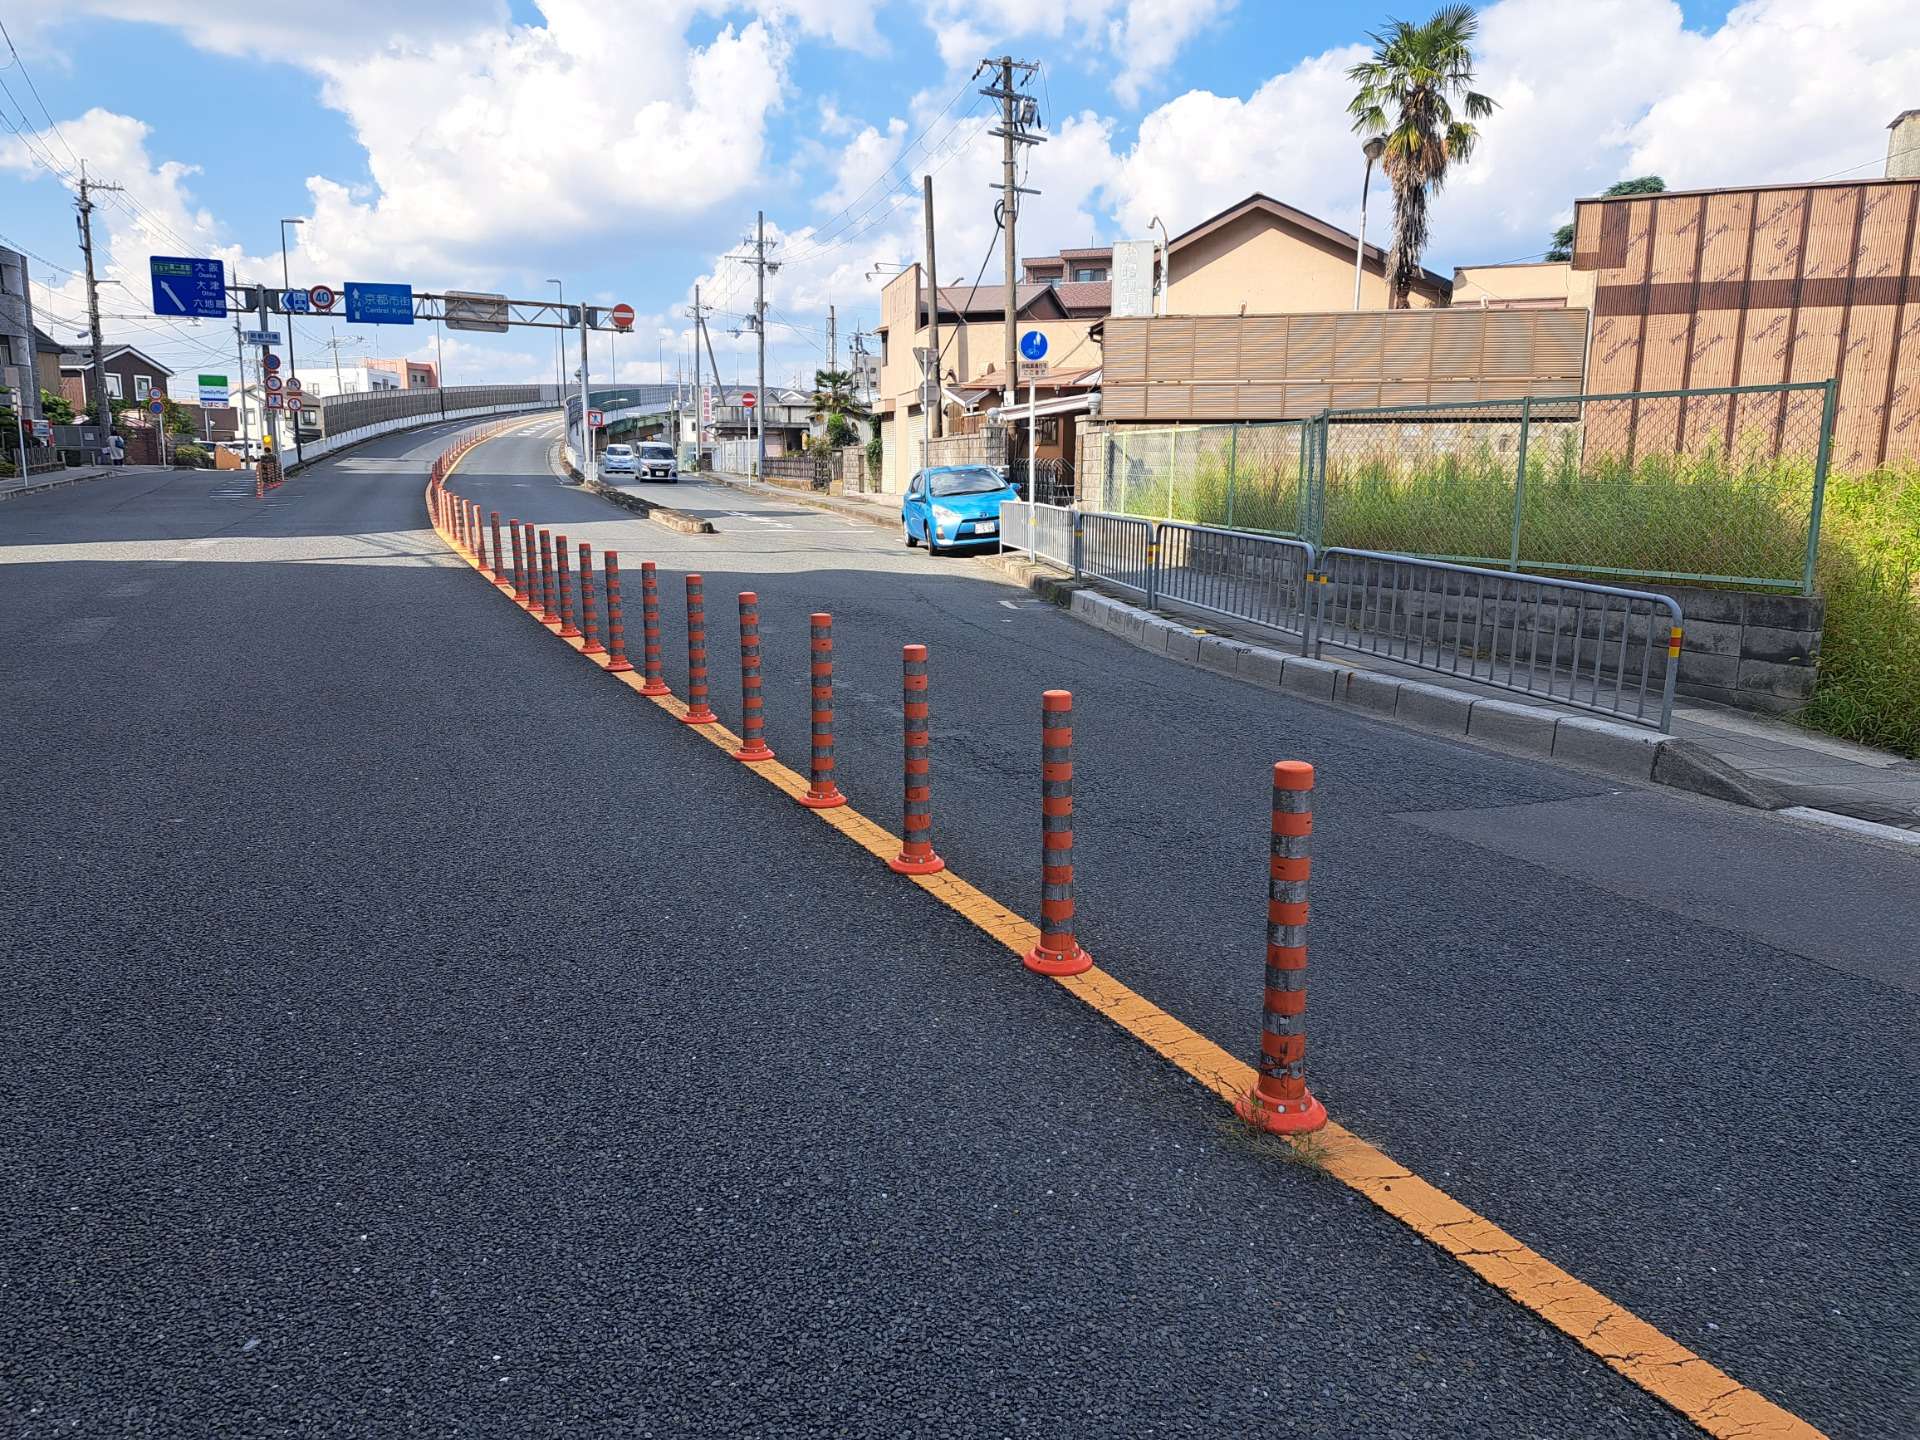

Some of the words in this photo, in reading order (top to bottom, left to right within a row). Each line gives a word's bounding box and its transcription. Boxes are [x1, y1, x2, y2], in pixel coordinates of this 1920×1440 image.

[195, 262, 219, 273] 大阪
[196, 280, 220, 291] 大津
[315, 291, 329, 303] 40
[363, 293, 411, 306] 京都市街
[365, 306, 391, 314] Central
[392, 307, 411, 316] Kyoto
